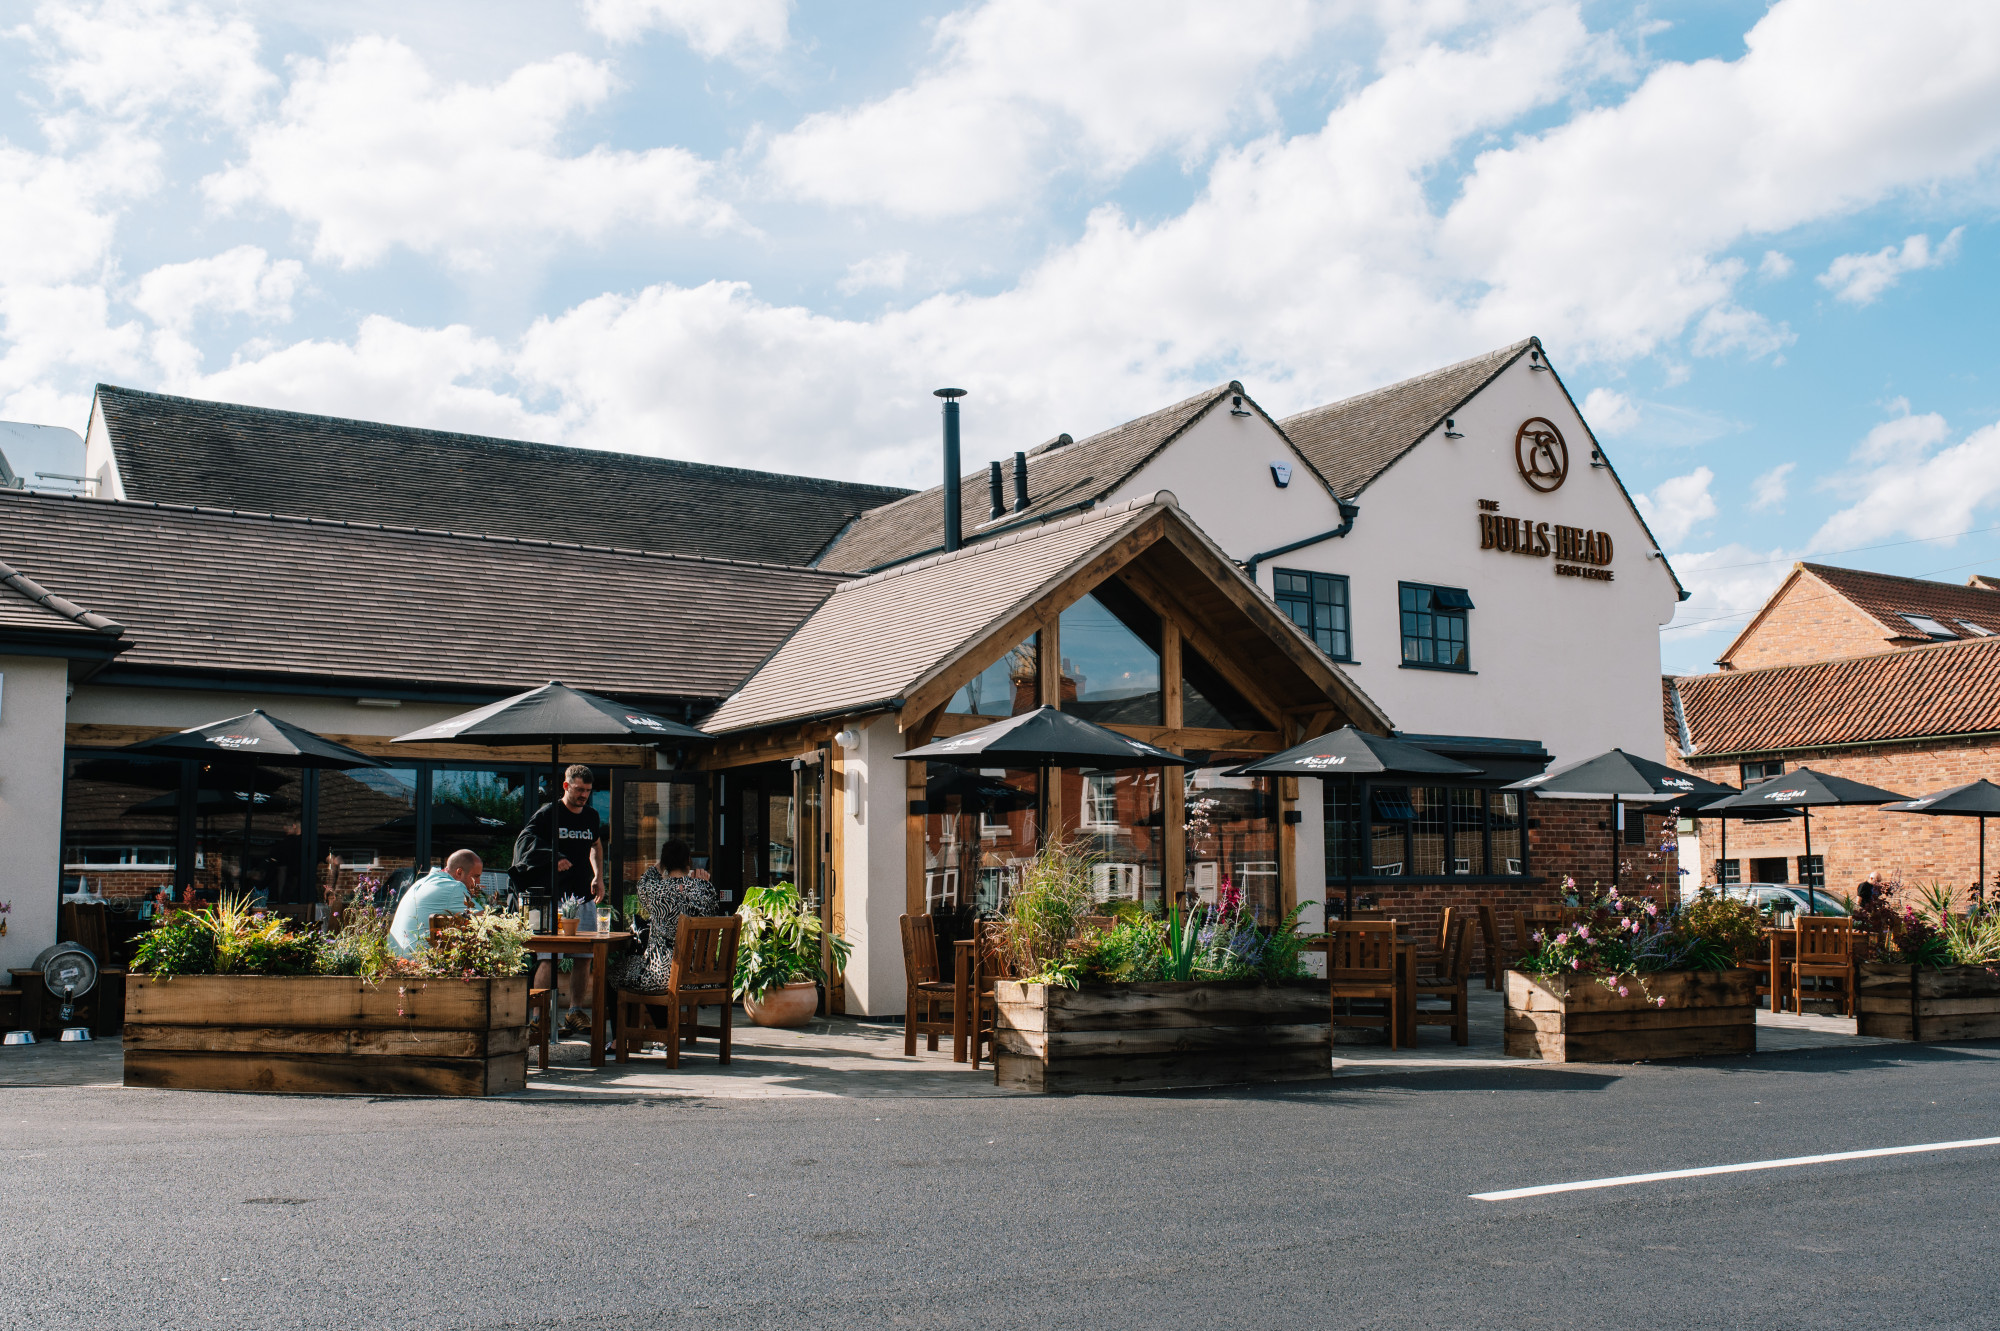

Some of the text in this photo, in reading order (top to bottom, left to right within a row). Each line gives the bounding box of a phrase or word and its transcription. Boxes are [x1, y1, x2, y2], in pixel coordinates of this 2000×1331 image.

[1478, 499, 1500, 511] THE
[1479, 513, 1613, 565] BULLS HEAD
[1556, 564, 1615, 581] EAST LEAKE
[1294, 756, 1347, 765] Asahi
[558, 827, 593, 840] Bench
